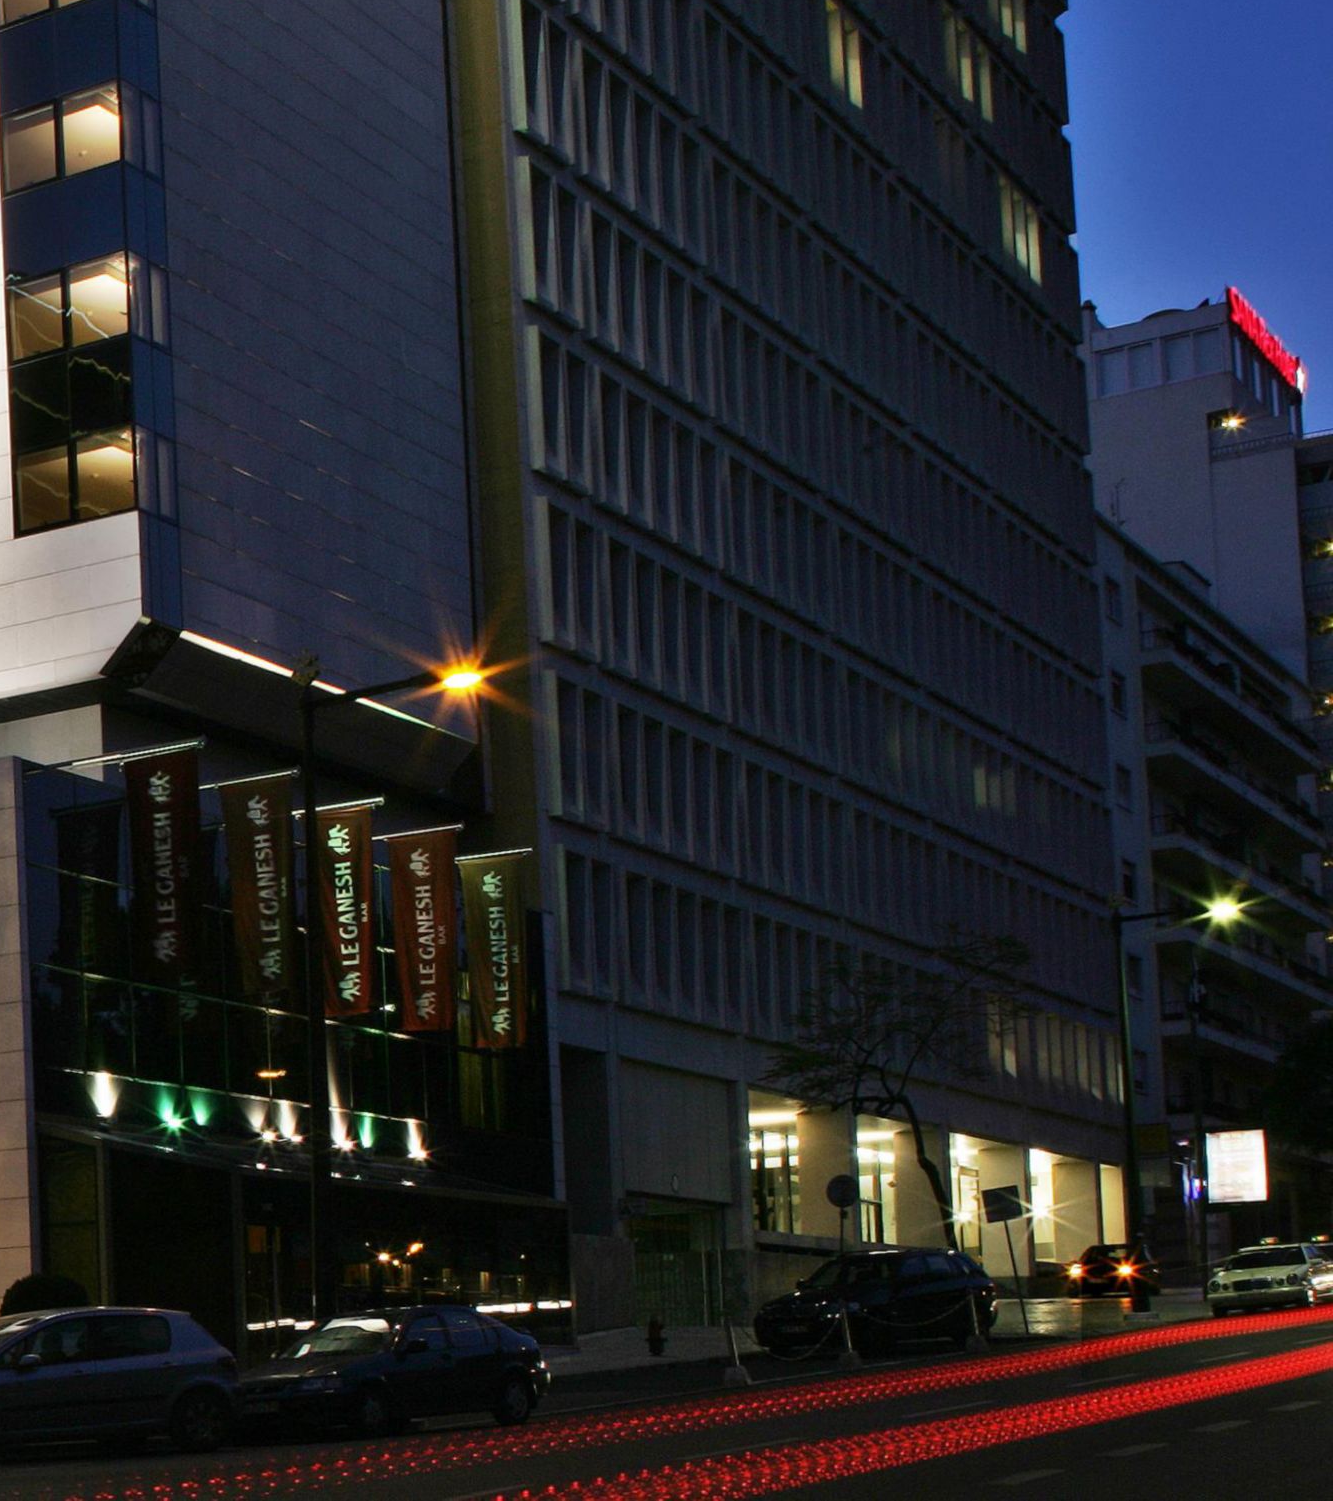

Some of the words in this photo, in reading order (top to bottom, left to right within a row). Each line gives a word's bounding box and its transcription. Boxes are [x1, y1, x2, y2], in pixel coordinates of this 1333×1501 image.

[153, 811, 175, 895] GANESH
[253, 833, 279, 916] GANESH
[157, 899, 176, 925] LE
[334, 860, 358, 940] GANESH
[360, 902, 369, 923] BAR
[259, 917, 281, 943] LE
[415, 884, 436, 960] GANESH
[438, 924, 447, 945] BAR
[340, 941, 360, 966] LE
[489, 905, 508, 978] GANESH
[420, 962, 436, 986] LE
[492, 979, 510, 1002] LE
